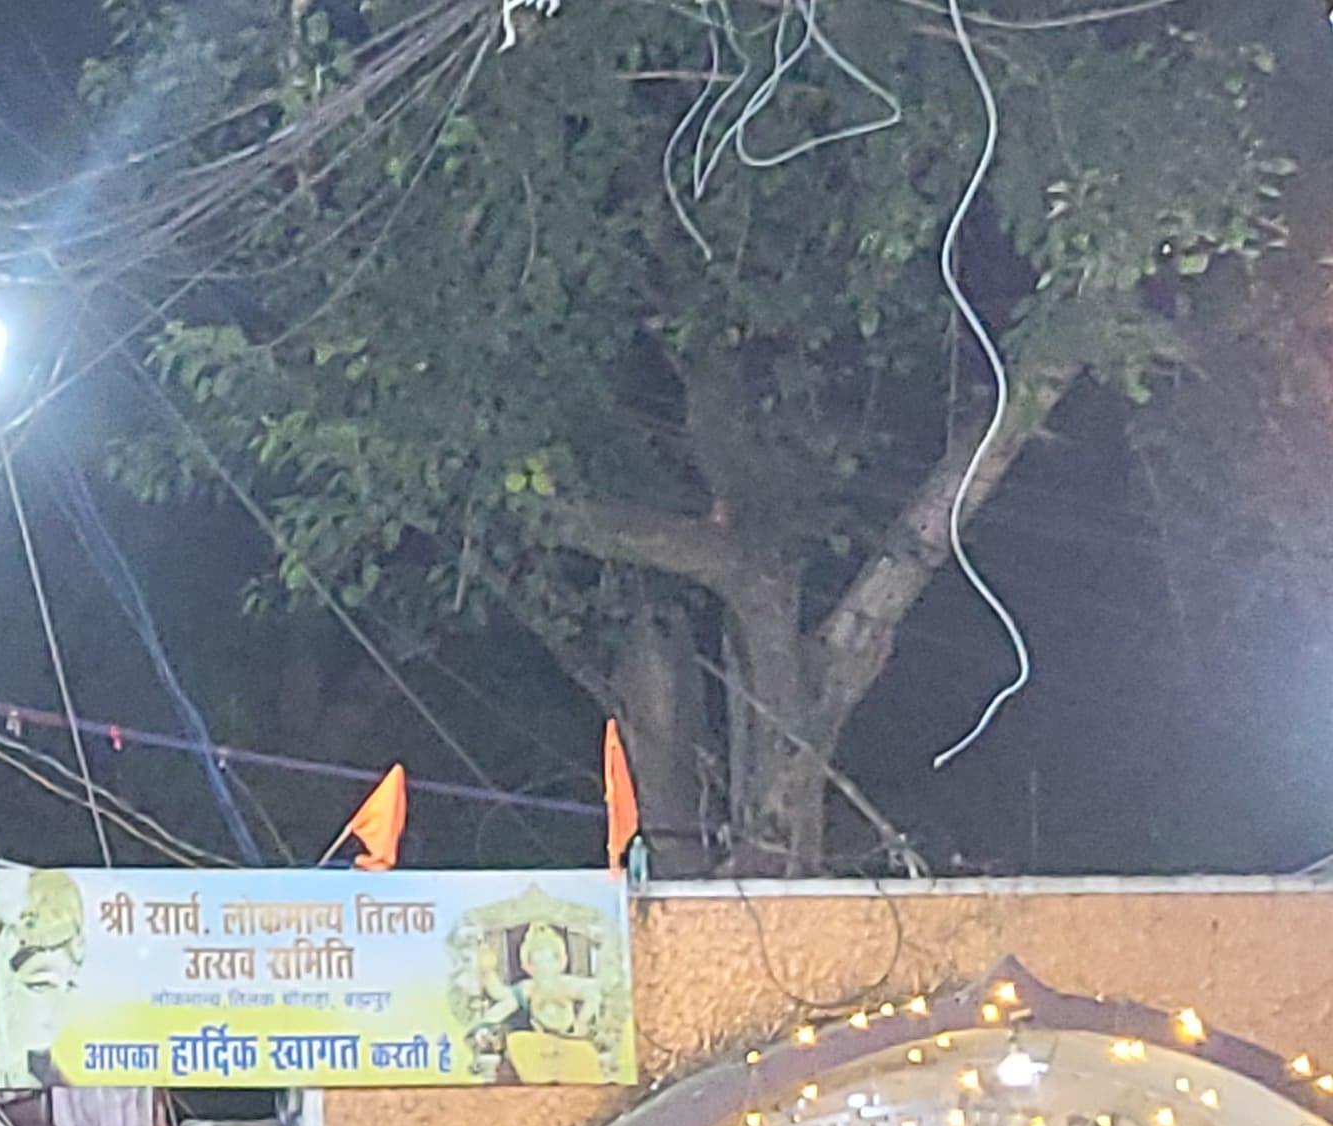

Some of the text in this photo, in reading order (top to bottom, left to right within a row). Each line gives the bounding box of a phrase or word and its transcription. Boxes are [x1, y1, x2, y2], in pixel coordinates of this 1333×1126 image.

[99, 890, 436, 935] श्री सार्व. लोकमान्य तिलक
[183, 937, 355, 980] उत्सव समिति
[84, 1042, 160, 1071] आपका
[168, 1022, 259, 1077] हार्दिक
[266, 1034, 361, 1071] स्वागत
[370, 1033, 429, 1070] करती
